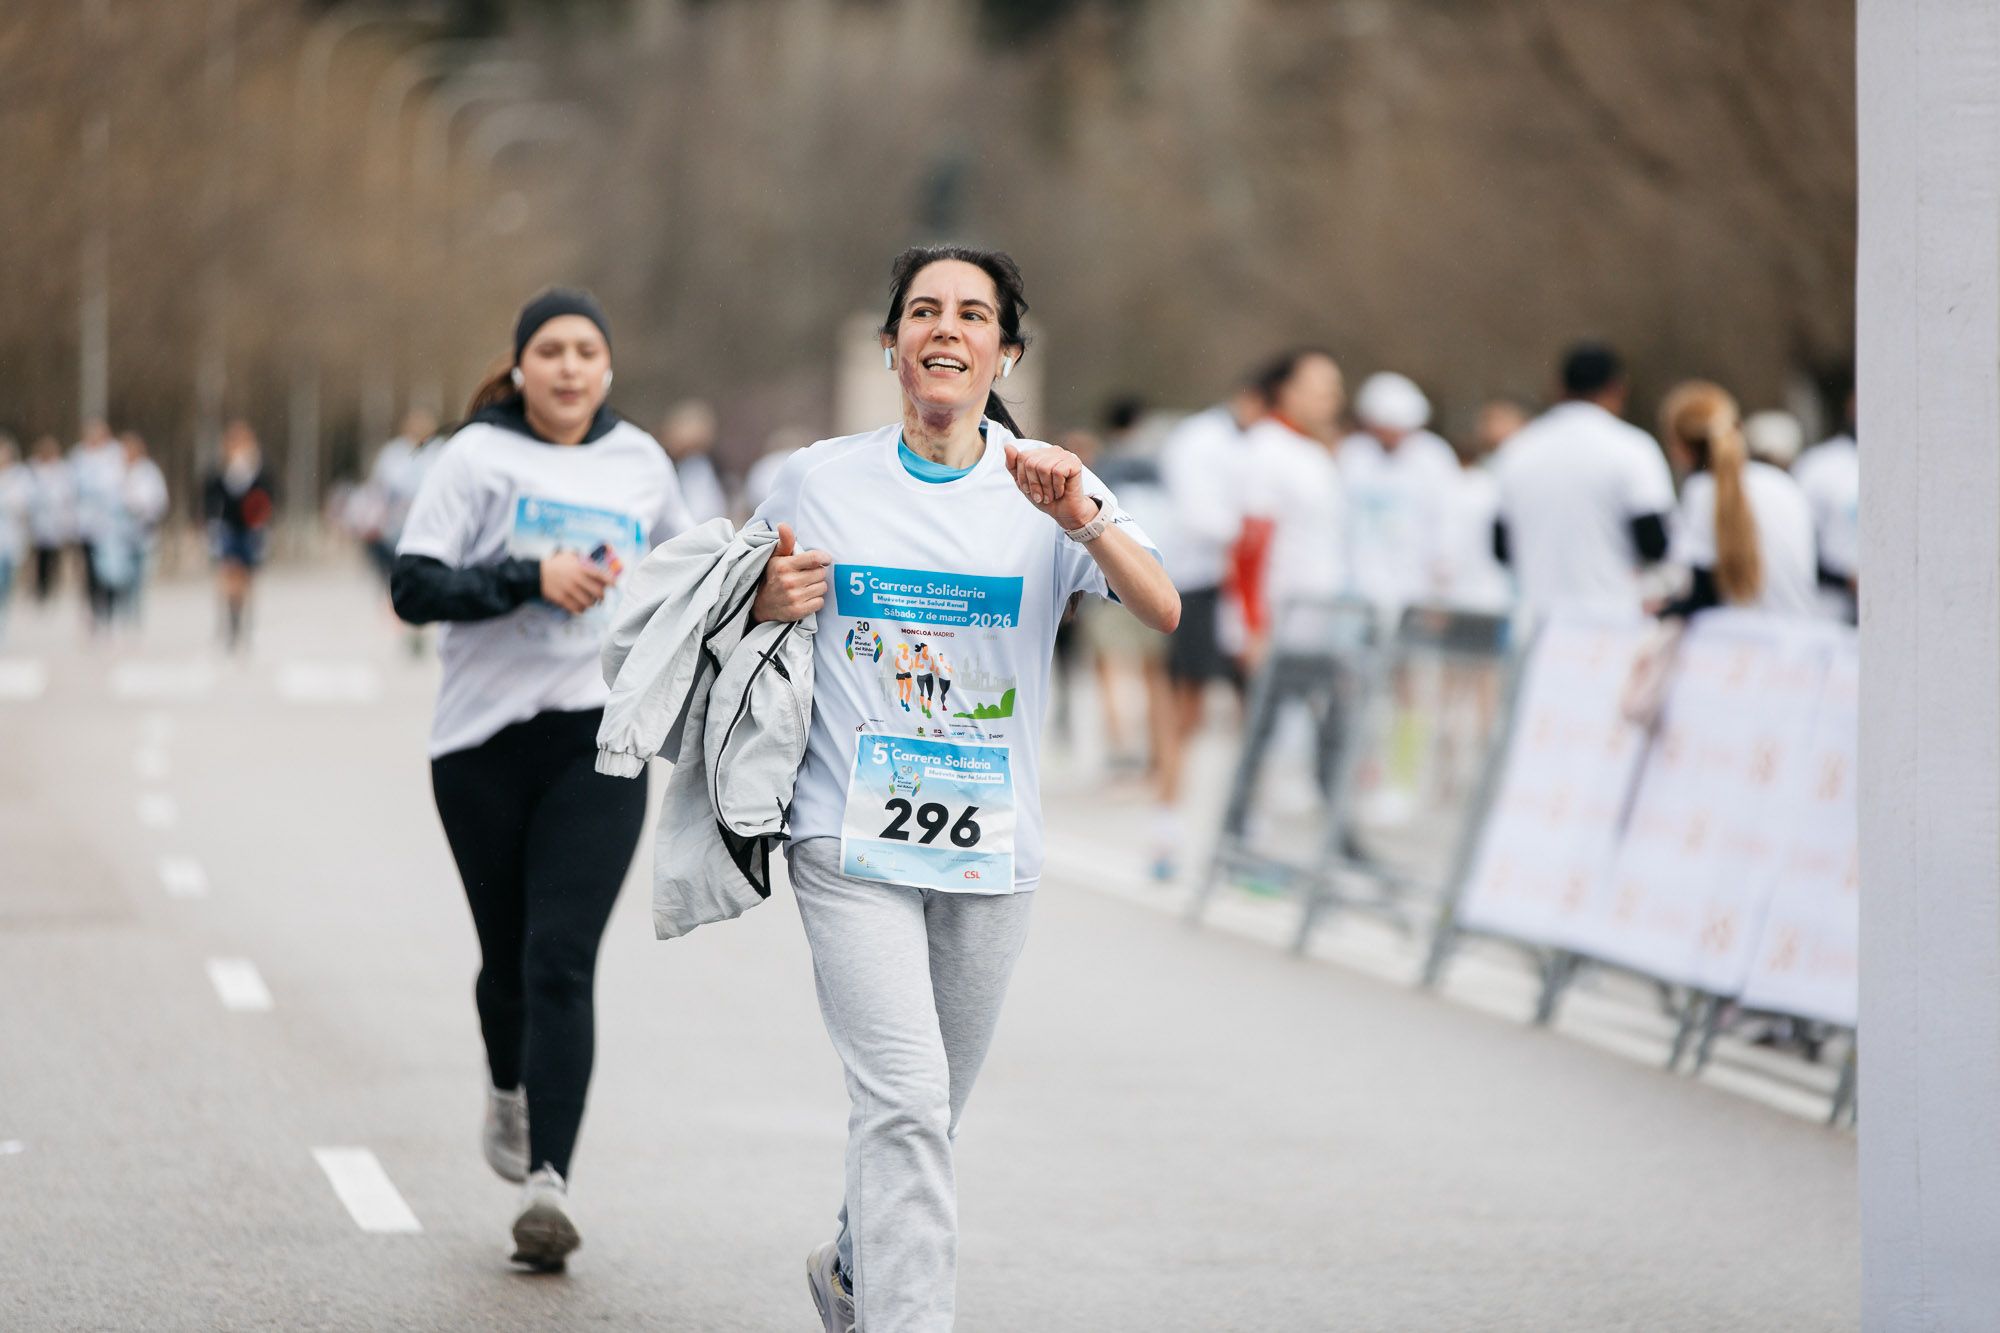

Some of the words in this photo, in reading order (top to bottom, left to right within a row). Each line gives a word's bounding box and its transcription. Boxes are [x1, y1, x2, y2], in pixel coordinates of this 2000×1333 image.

[869, 577, 922, 594] Carrera
[926, 582, 986, 599] Solidaria
[884, 607, 916, 619] Sábado
[918, 611, 924, 619] 7
[925, 612, 938, 621] de
[938, 615, 967, 623] marzo
[969, 612, 1012, 628] 2026
[856, 620, 870, 632] 20
[901, 628, 932, 636] MONCLOA
[932, 630, 955, 638] MADRID
[891, 749, 941, 765] Carrera
[879, 798, 981, 848] 296
[964, 870, 981, 880] CSL
